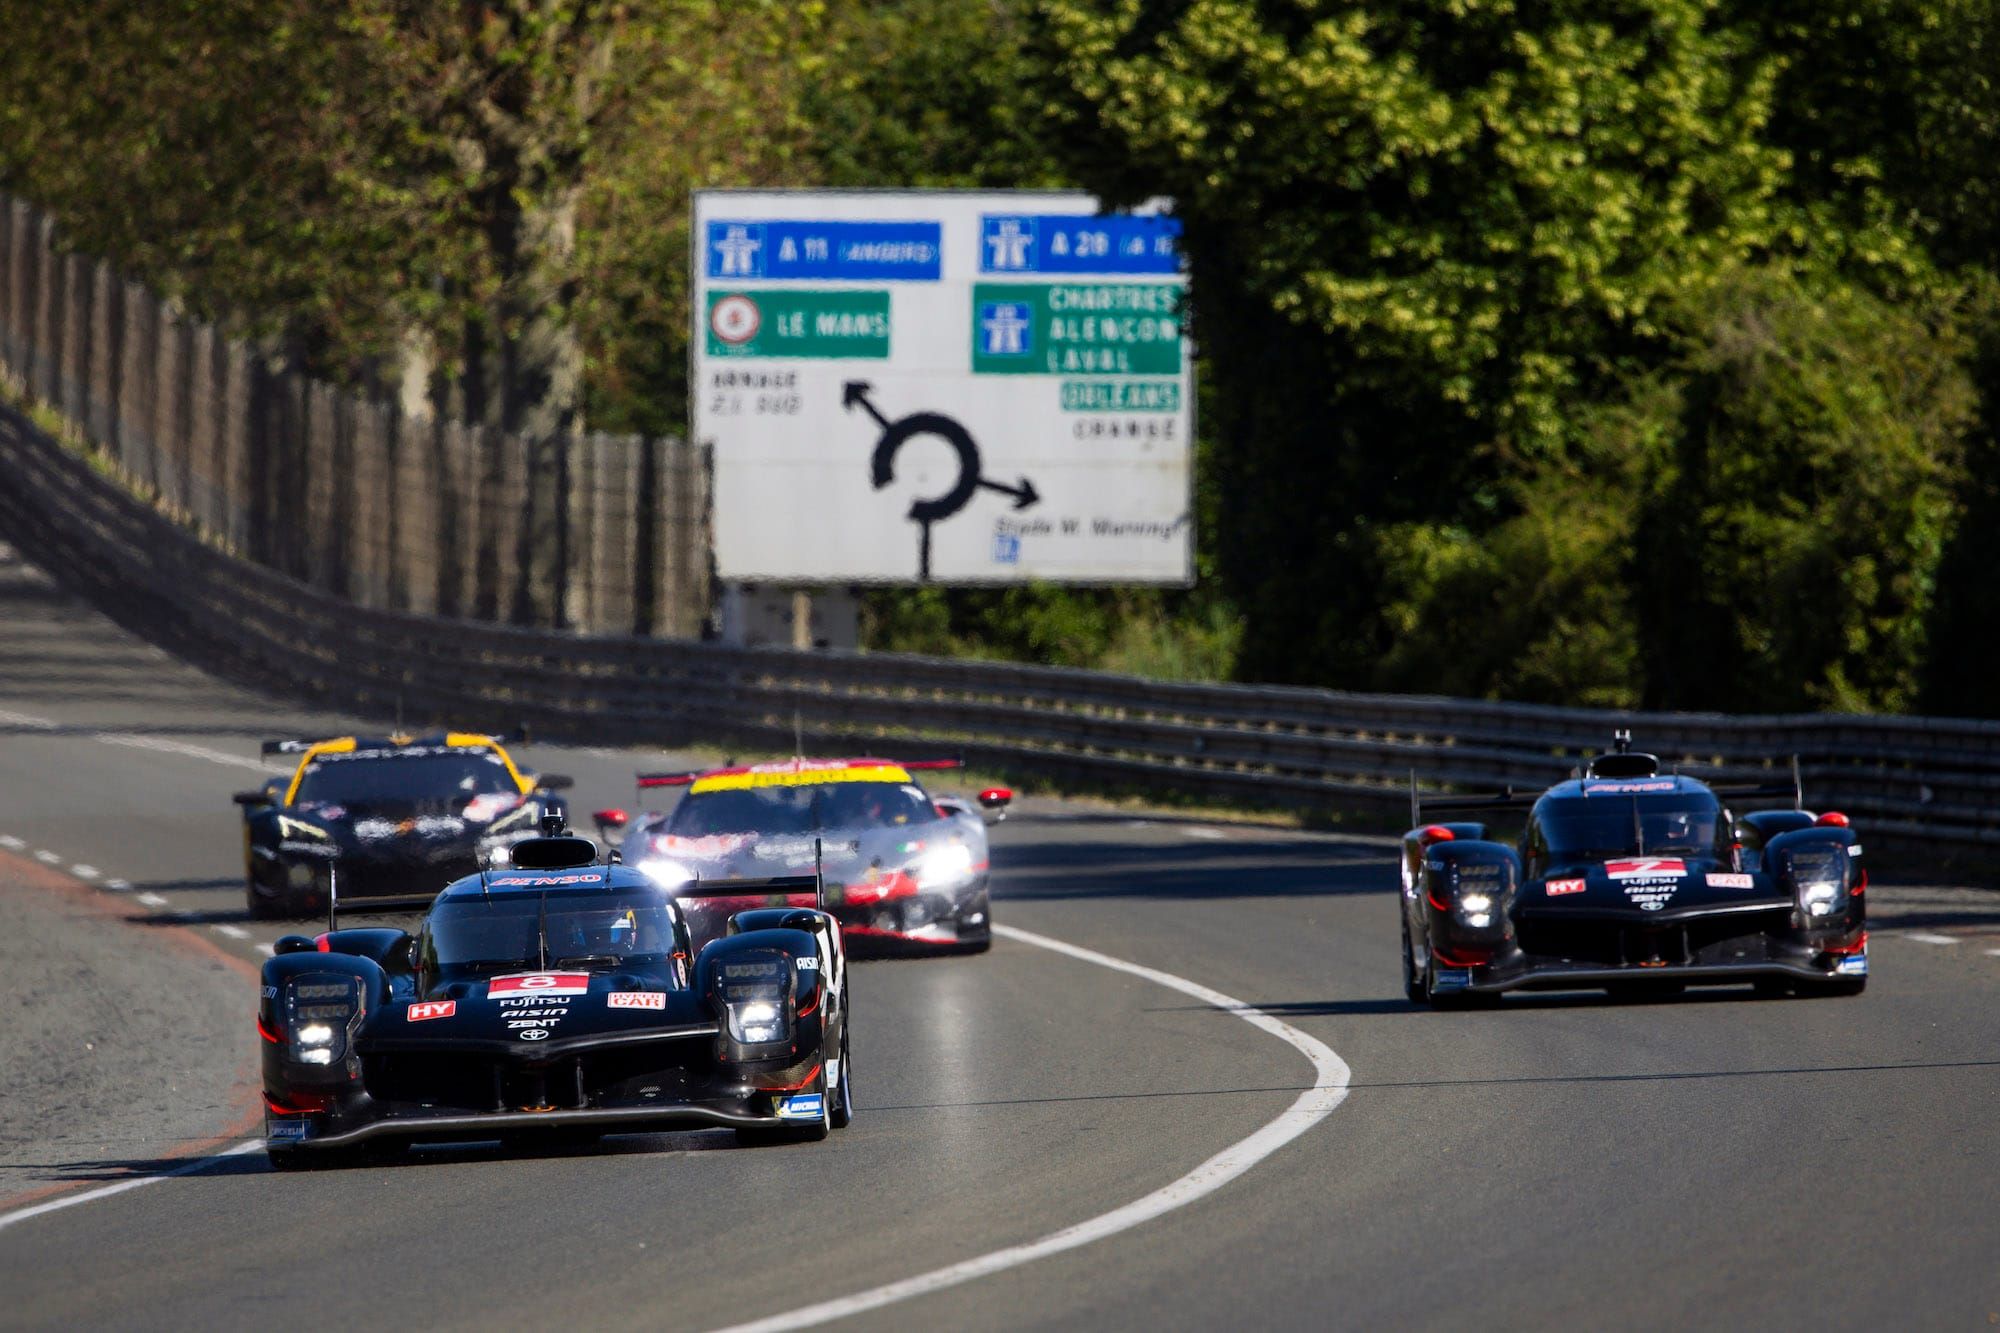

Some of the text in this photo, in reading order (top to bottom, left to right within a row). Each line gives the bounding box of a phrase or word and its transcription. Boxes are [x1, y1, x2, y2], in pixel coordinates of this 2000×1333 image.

[779, 237, 797, 261] A
[1051, 232, 1070, 255] A
[777, 312, 888, 338] LE MANS
[1048, 348, 1129, 370] LAVAL
[489, 875, 602, 886] DENSO
[1621, 876, 1678, 886] FUJITSU
[1549, 881, 1581, 894] HY
[1631, 893, 1673, 903] ZENT
[519, 976, 556, 988] 8
[500, 996, 570, 1007] FUJITSU
[614, 998, 660, 1007] CAR
[411, 1002, 451, 1017] HY
[501, 1008, 568, 1018] AISIN
[507, 1018, 560, 1028] ZENT
